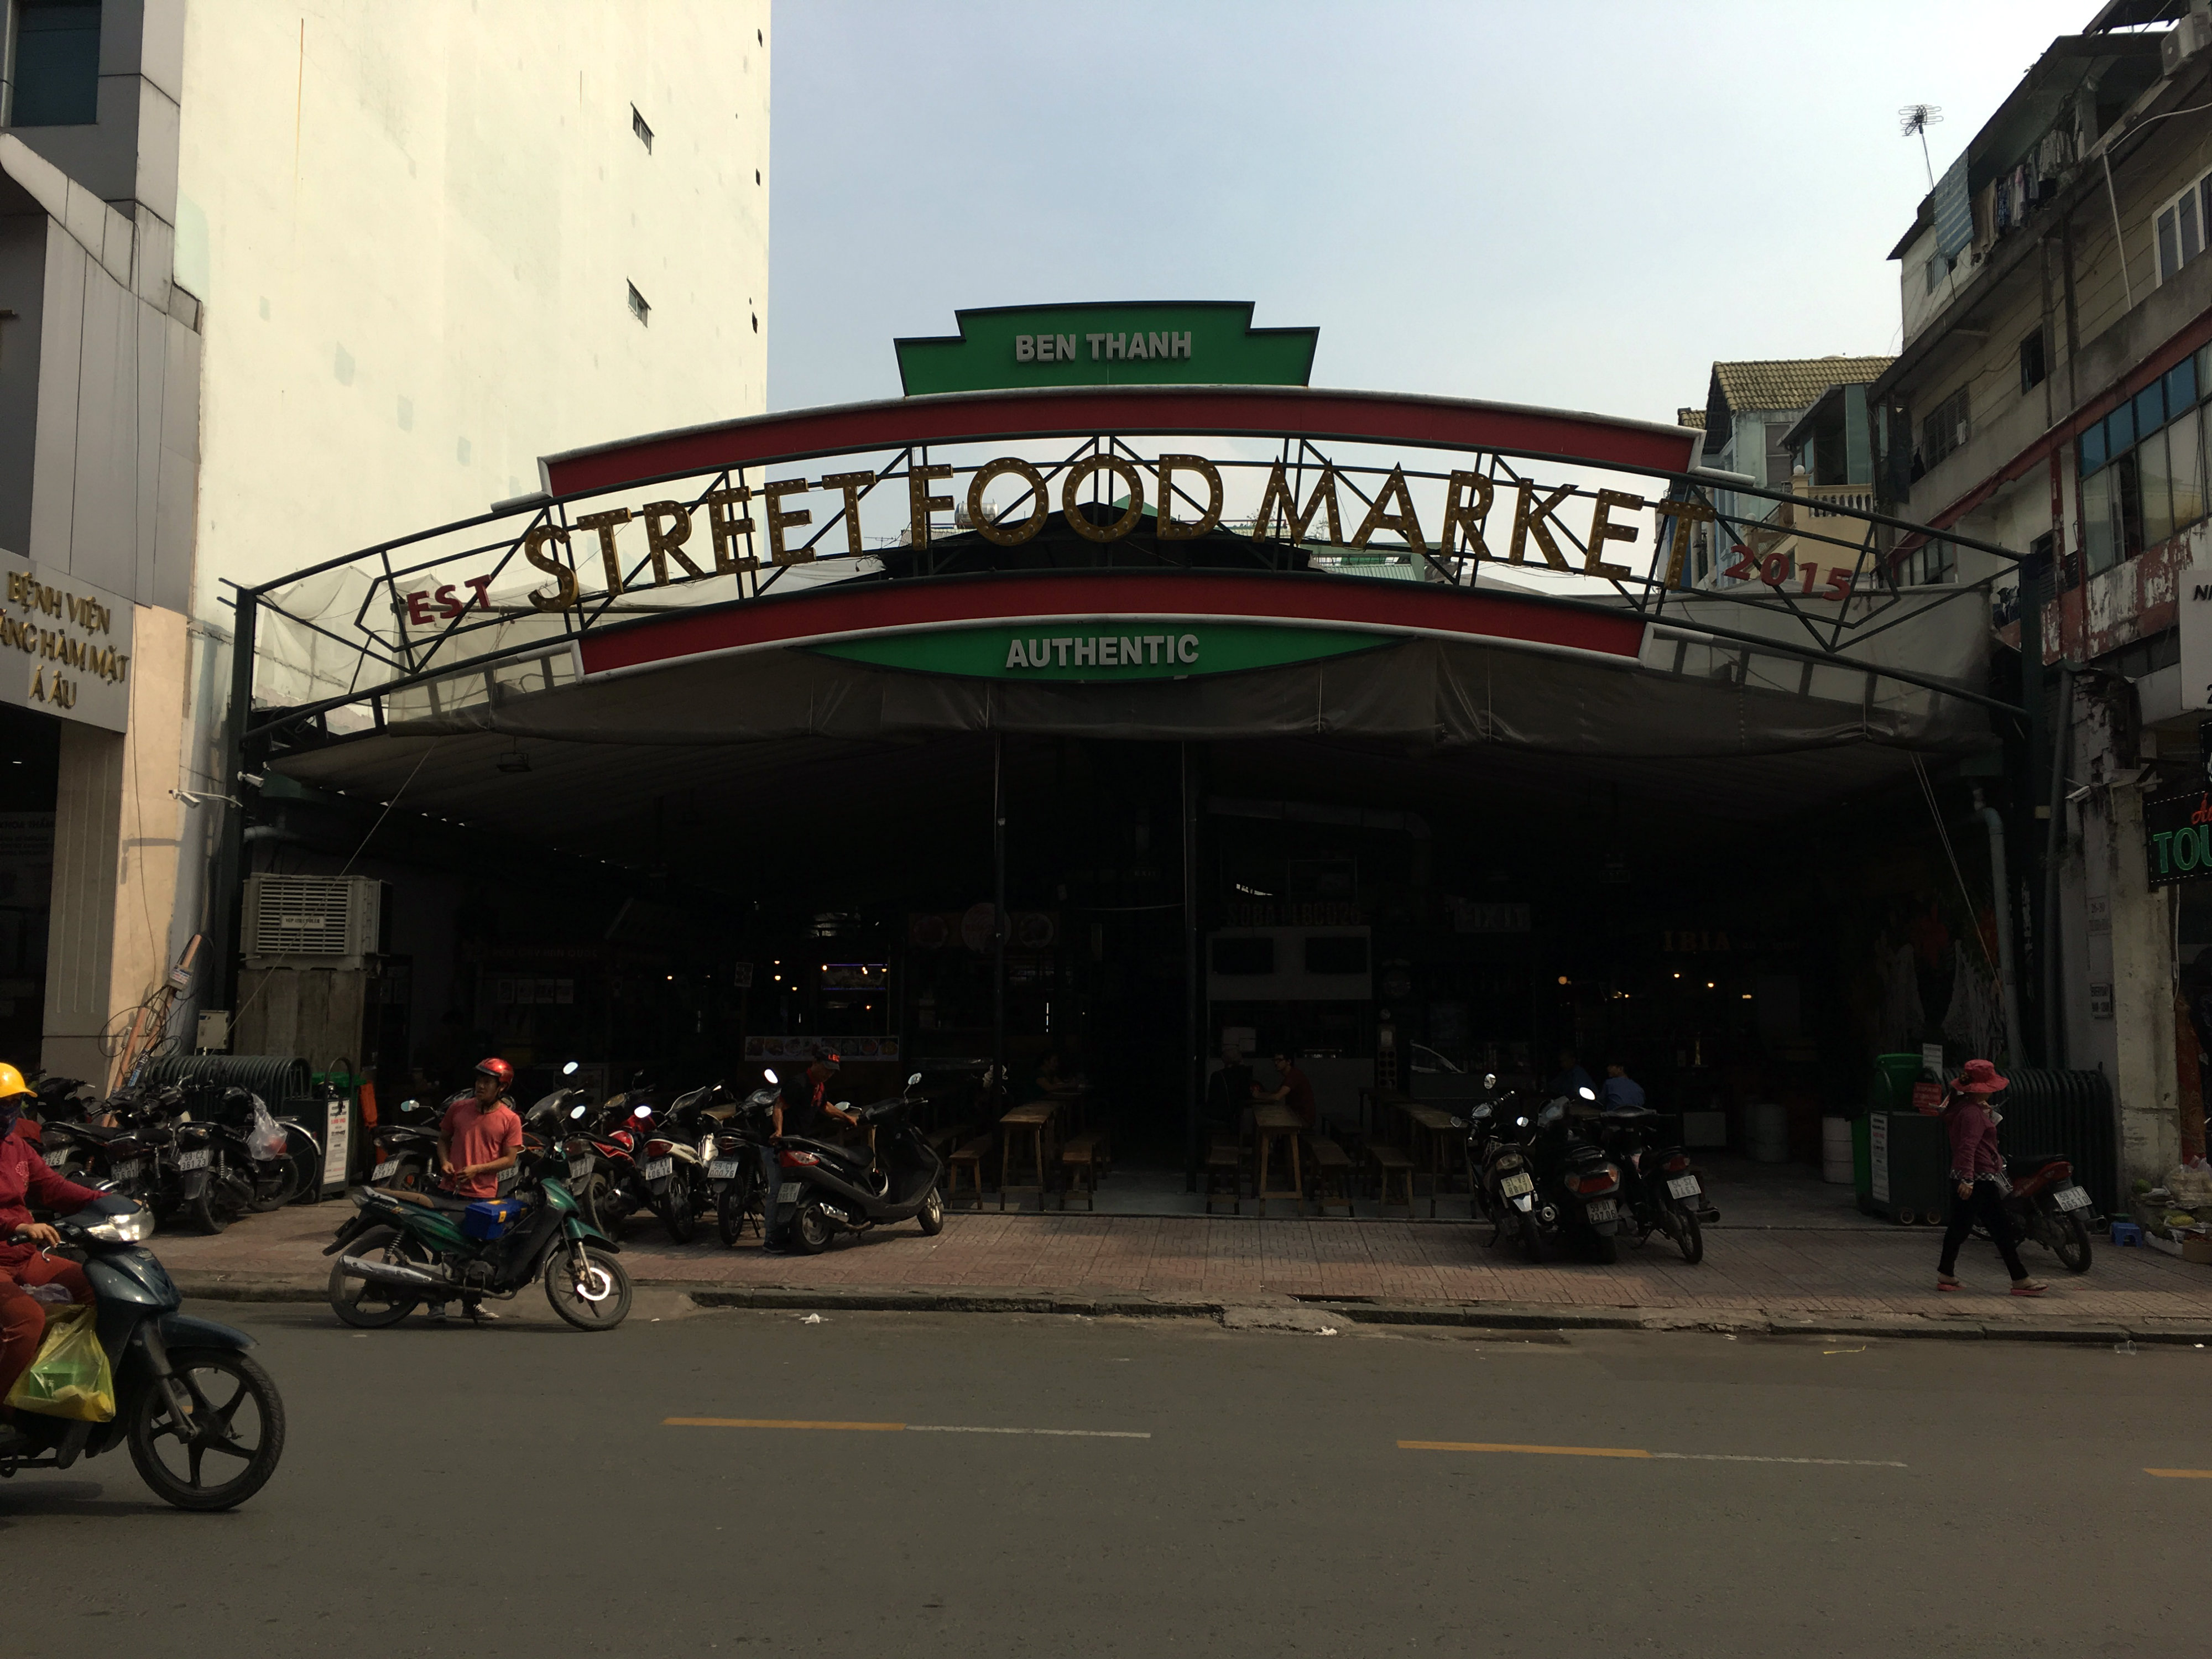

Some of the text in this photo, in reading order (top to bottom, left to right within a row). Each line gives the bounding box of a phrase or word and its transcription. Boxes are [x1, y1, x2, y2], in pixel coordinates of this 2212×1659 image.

[1016, 331, 1192, 362] BEN THANH
[524, 454, 1717, 612] STREET FOOD MARKET
[407, 574, 493, 625] EST
[1724, 545, 1853, 601] 2015
[8, 571, 111, 635] BỆNH VIỆN
[40, 629, 86, 671] HÀM
[89, 645, 129, 686] MẶT
[1005, 634, 1199, 669] AUTHENTIC
[29, 664, 45, 702] Á
